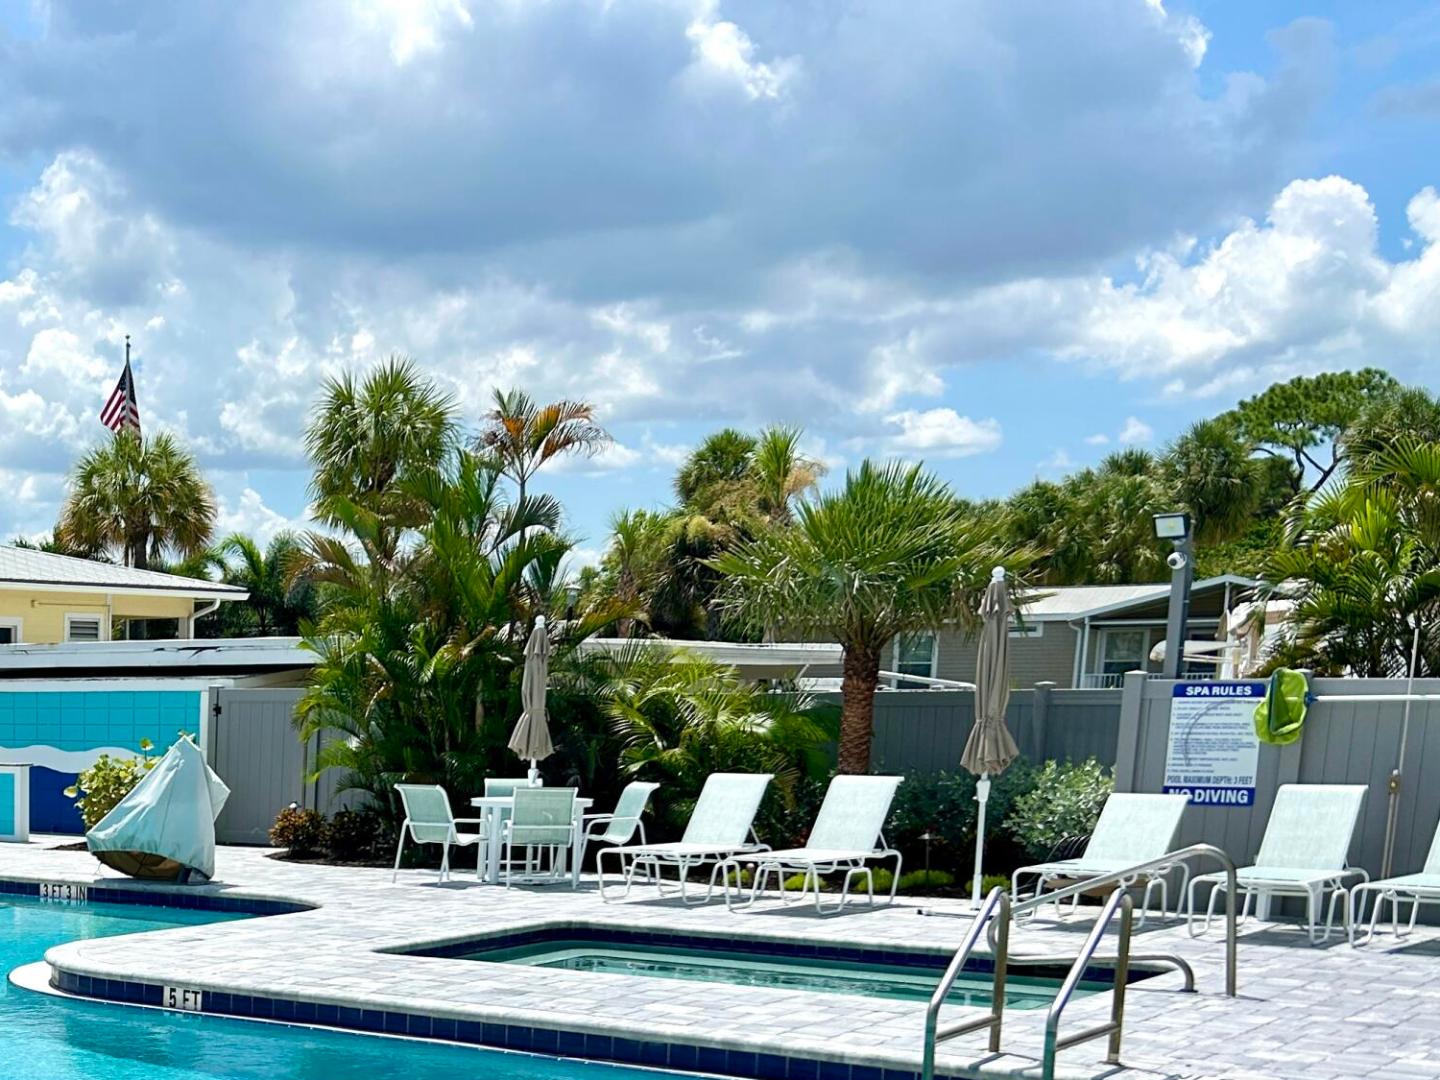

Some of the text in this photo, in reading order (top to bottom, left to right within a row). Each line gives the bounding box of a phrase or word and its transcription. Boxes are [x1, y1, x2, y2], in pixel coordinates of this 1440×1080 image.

[1185, 686, 1252, 696] SPA RULES
[1167, 775, 1181, 784] POOL
[1183, 775, 1211, 784] MAXIMUM
[1239, 776, 1253, 785] FEET
[1194, 789, 1249, 804] DIVING
[43, 883, 86, 899] 3 FT 3 IN
[169, 988, 201, 1011] 5 FT
